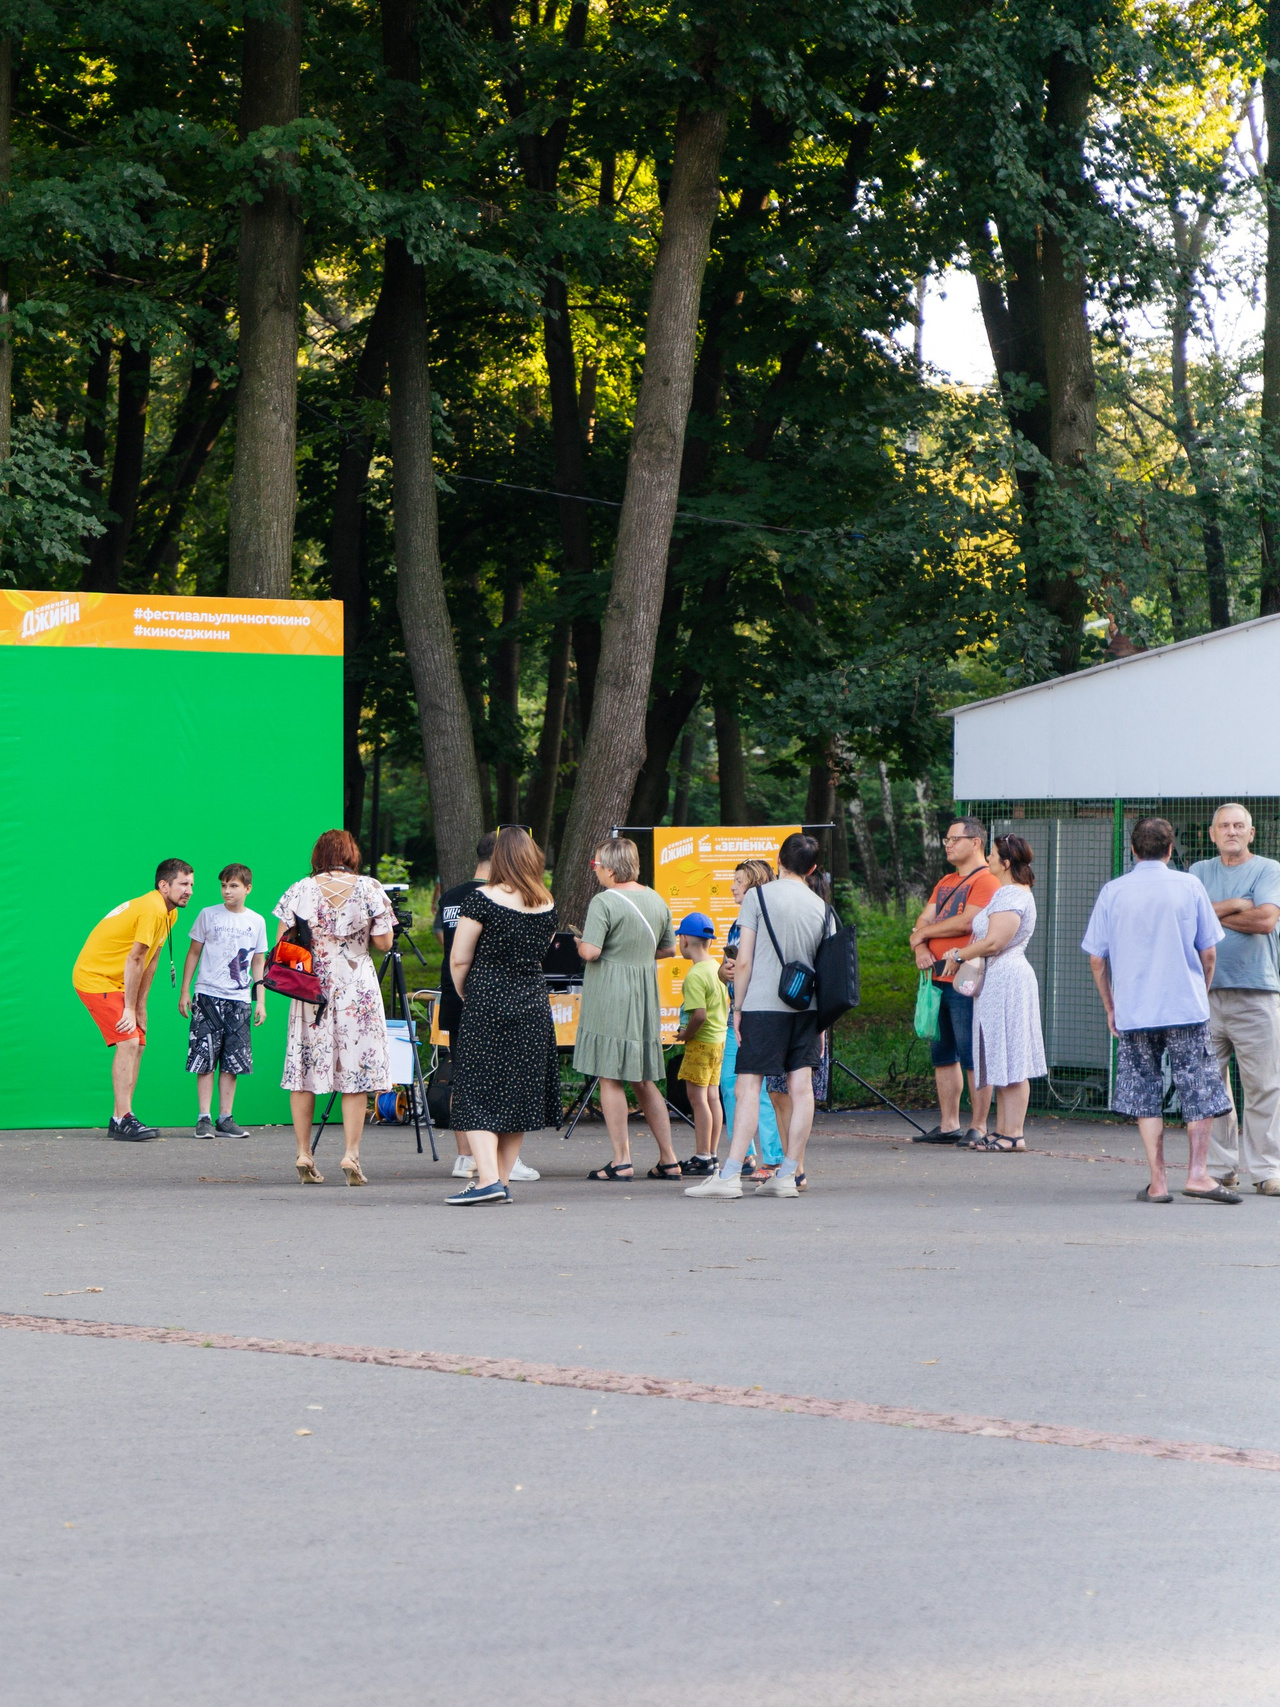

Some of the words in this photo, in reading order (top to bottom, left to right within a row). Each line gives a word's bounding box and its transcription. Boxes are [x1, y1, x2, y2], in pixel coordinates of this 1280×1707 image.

[133, 607, 311, 626] #фестивальуличногокино
[133, 625, 230, 640] #киносджинн
[715, 839, 780, 852] «ЗЕЛЁНКА»
